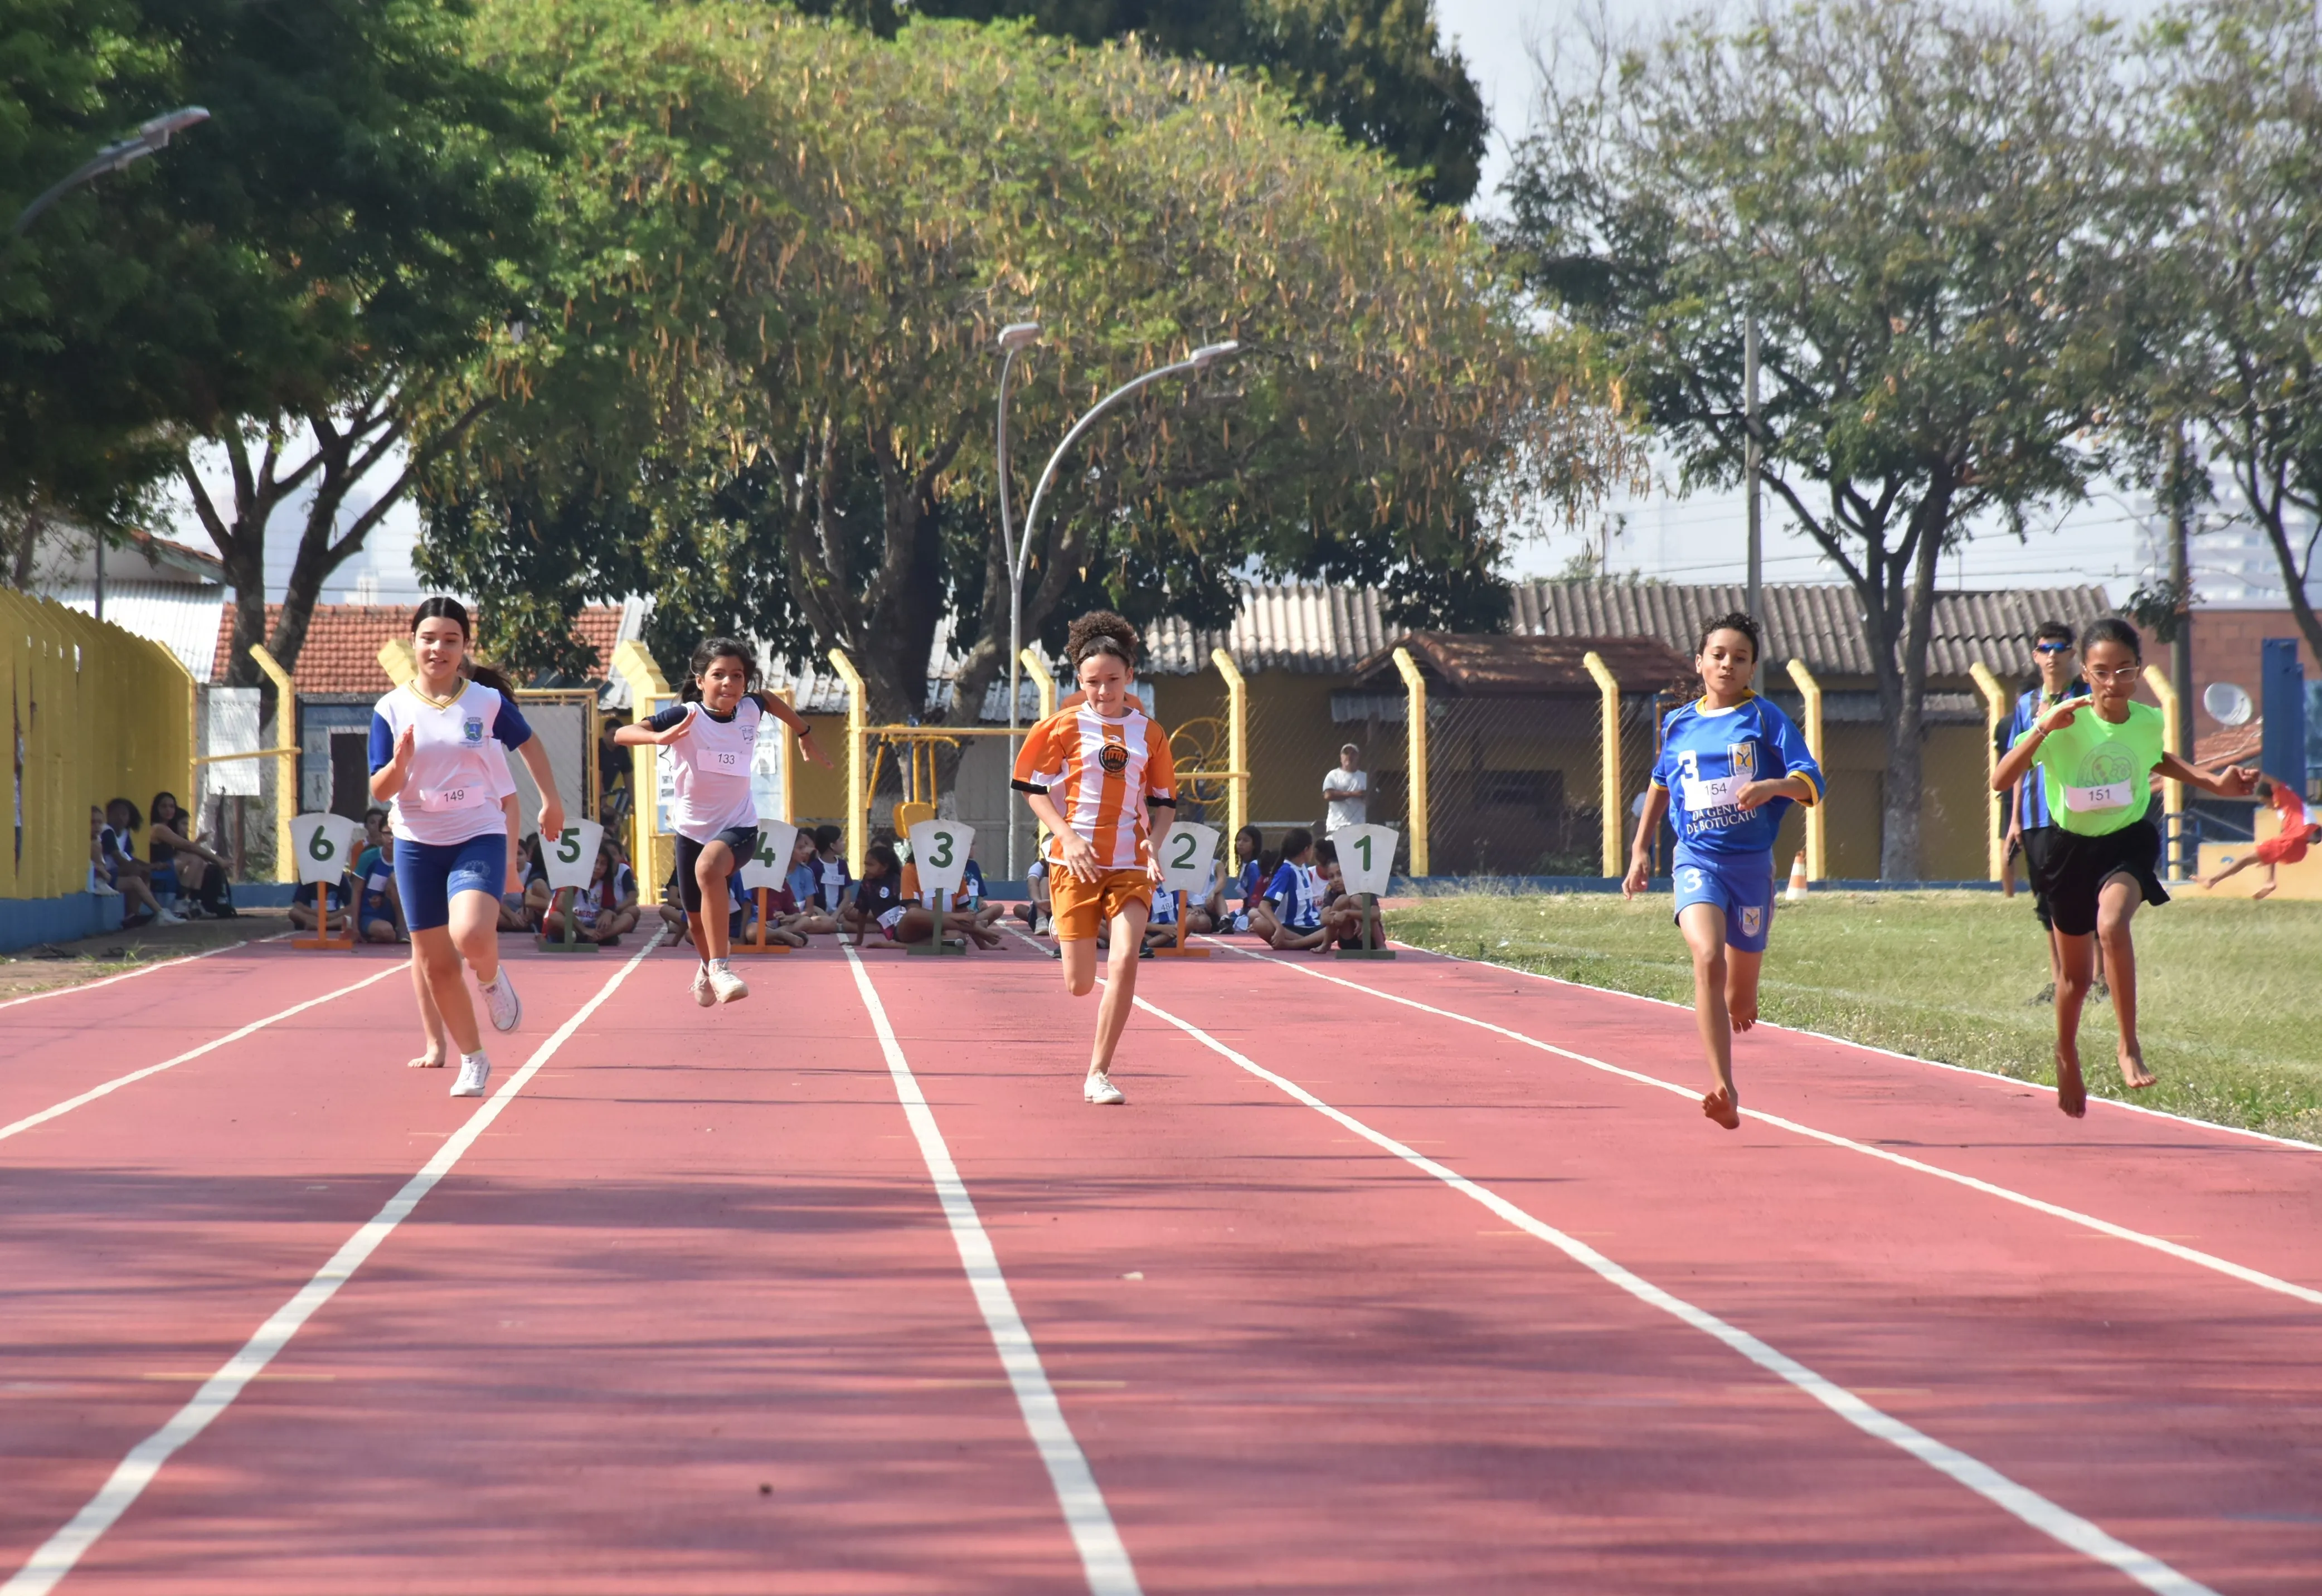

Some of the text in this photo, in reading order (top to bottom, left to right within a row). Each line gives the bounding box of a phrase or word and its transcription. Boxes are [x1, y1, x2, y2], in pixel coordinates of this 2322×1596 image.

[718, 753, 735, 765] 133
[1678, 750, 1699, 784] 3
[444, 790, 464, 802] 149
[1704, 782, 1727, 796] 154
[2088, 789, 2110, 801] 151
[1686, 807, 1757, 835] DE BOTUCATU
[1692, 802, 1738, 821] DA GENT
[309, 825, 335, 862] 6
[556, 828, 581, 863] 5
[753, 831, 776, 868] 4
[929, 831, 954, 868] 3
[1171, 833, 1197, 869] 2
[1354, 835, 1371, 872] 1
[1683, 868, 1703, 893] 3
